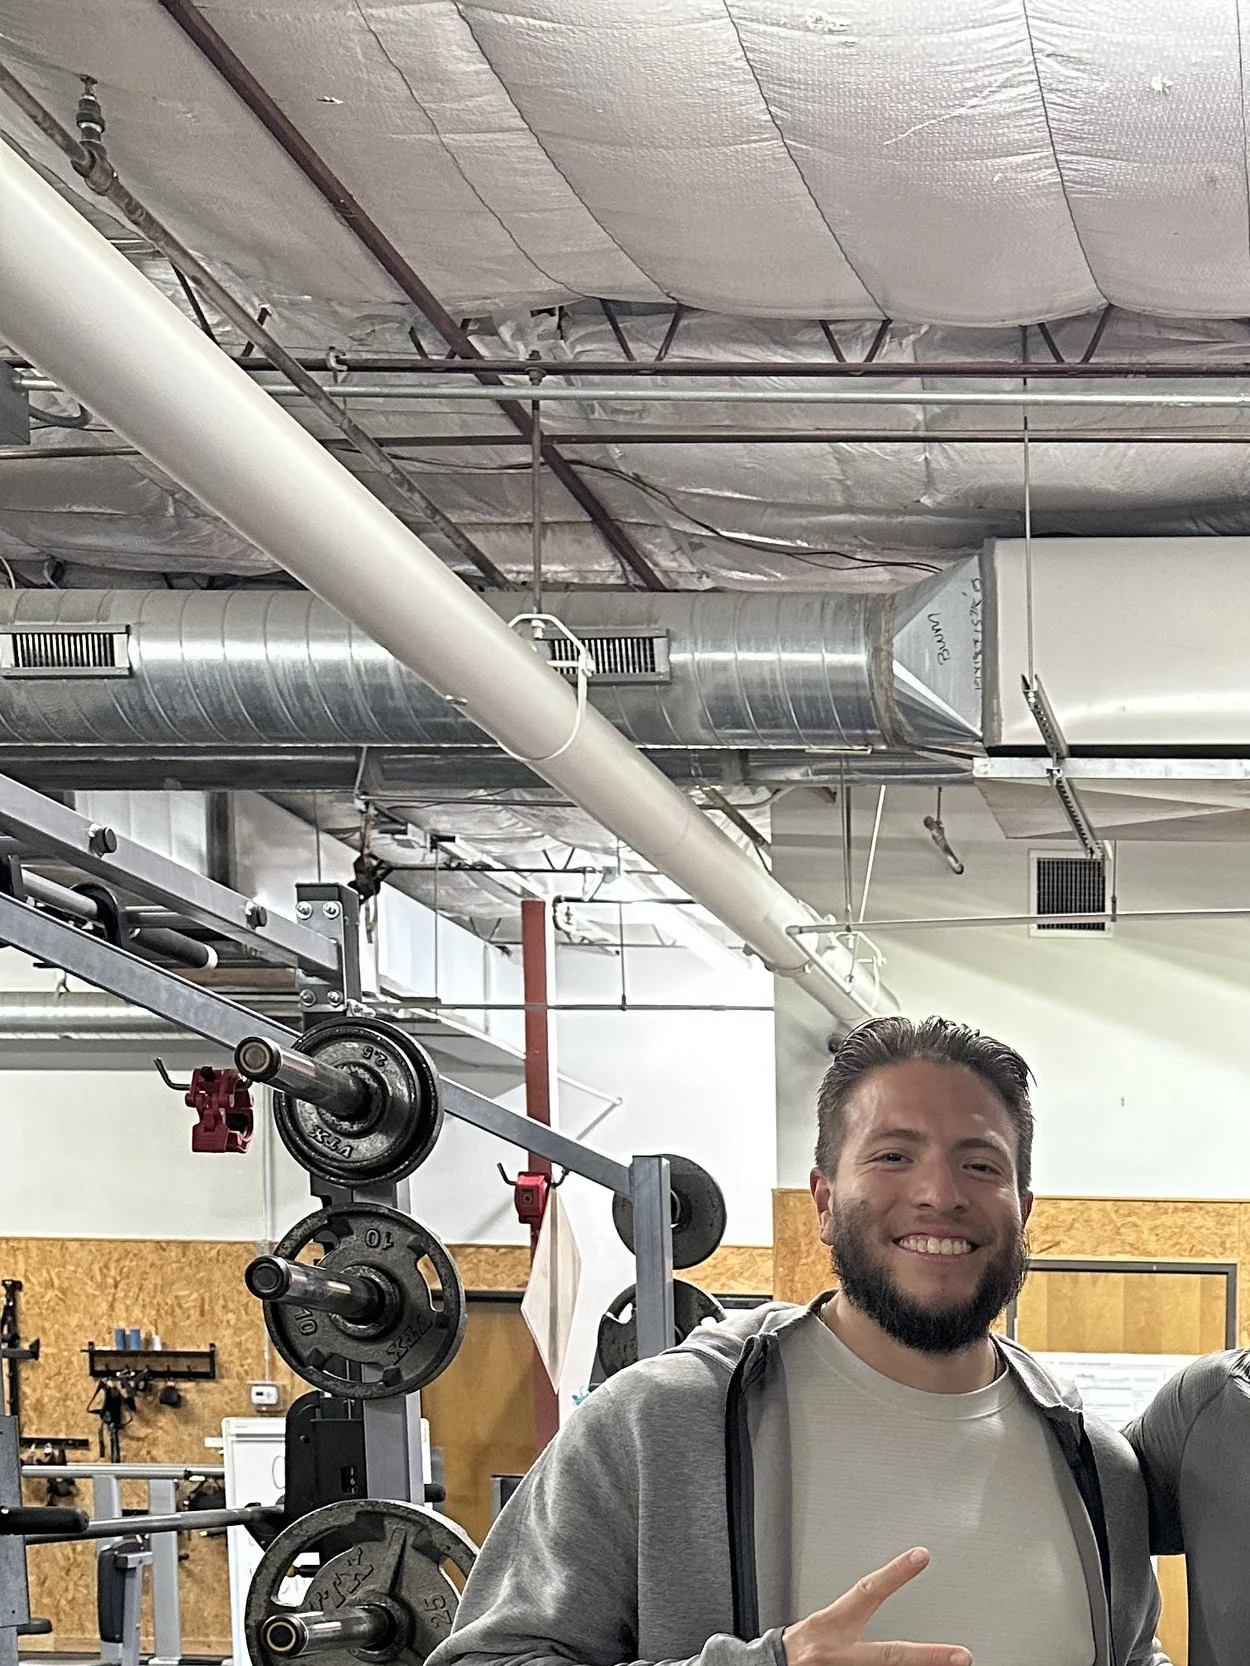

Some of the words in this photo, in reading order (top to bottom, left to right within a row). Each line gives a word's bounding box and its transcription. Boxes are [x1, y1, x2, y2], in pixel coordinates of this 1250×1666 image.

[365, 1228, 395, 1251] 10
[294, 1307, 318, 1337] 10
[422, 1593, 452, 1629] 25
